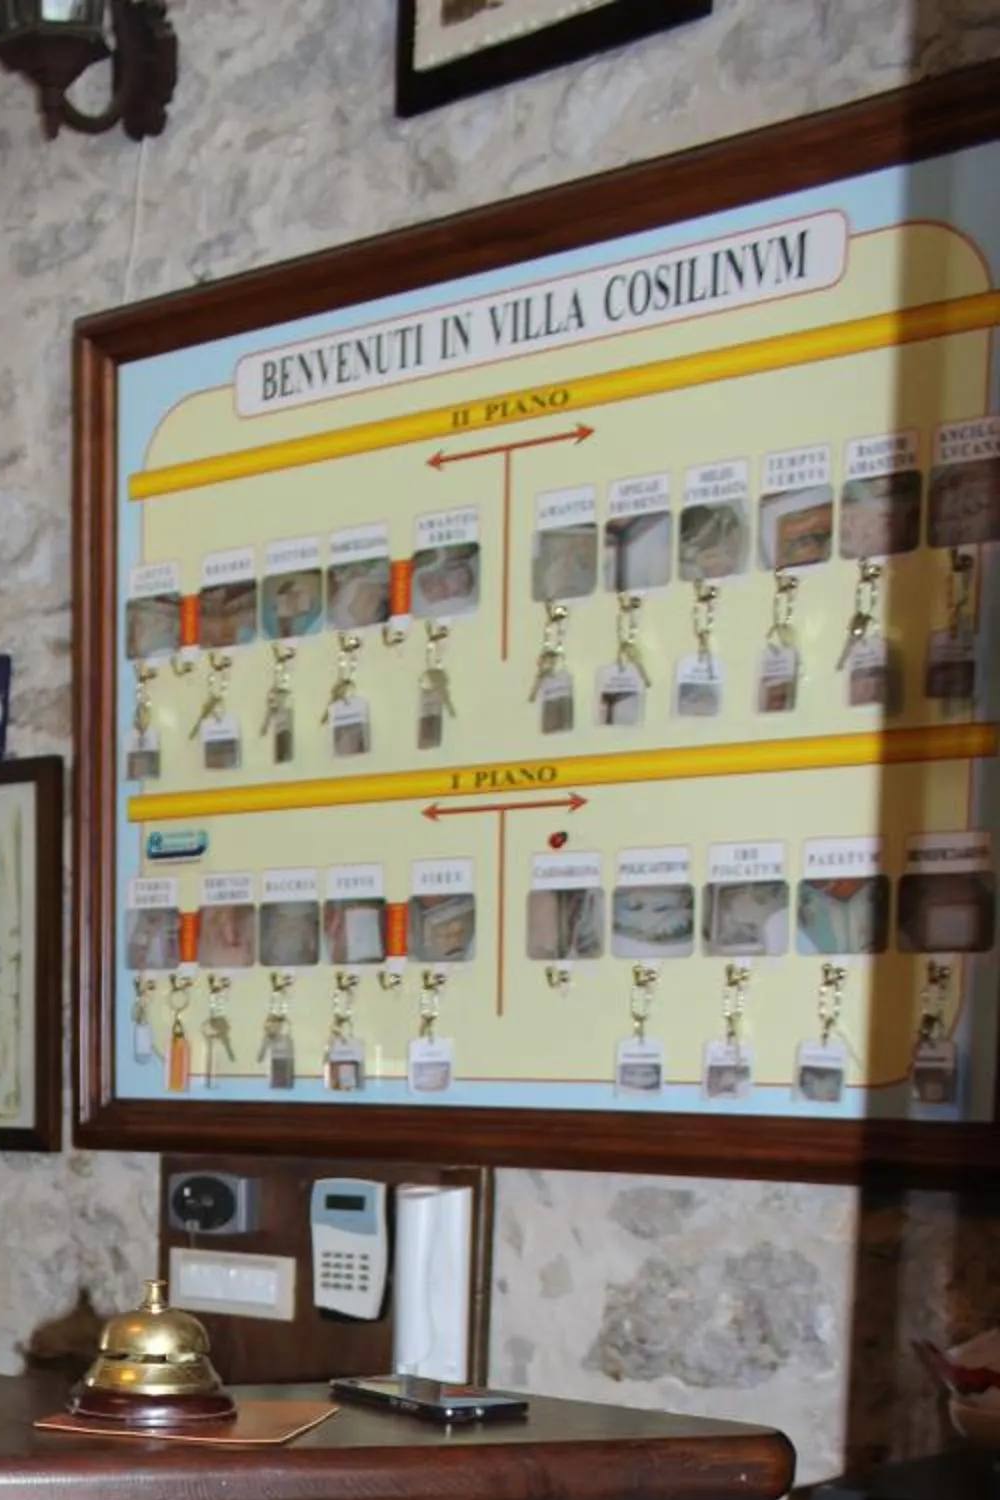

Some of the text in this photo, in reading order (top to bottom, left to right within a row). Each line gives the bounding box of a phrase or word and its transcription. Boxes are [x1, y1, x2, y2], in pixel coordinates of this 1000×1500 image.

[261, 230, 810, 402] BENVENUTI IN VILLA COSILINVM
[483, 388, 571, 423] PIANO
[474, 765, 559, 788] PIANO
